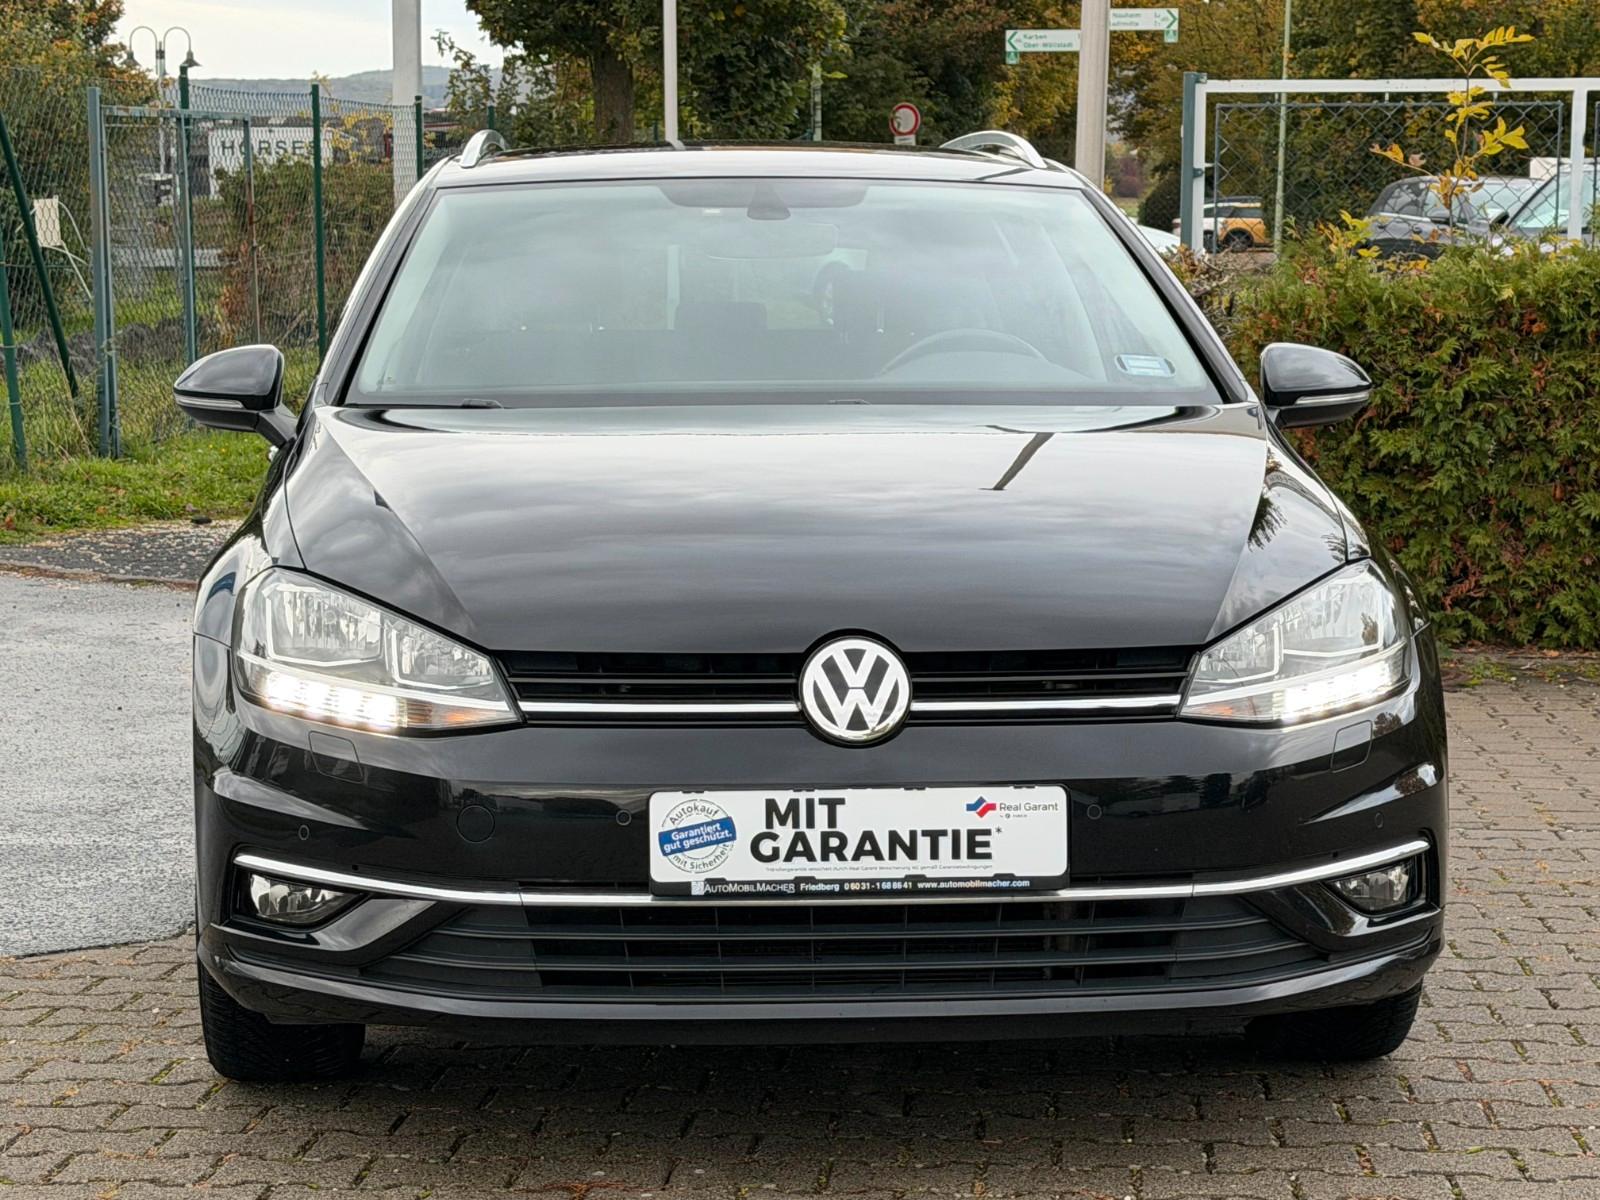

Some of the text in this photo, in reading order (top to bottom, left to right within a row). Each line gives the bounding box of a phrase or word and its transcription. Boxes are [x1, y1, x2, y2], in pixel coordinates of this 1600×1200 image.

[669, 802, 720, 825] Autokauf
[765, 797, 846, 830] MIT
[999, 802, 1059, 812] Real Garant
[671, 823, 721, 840] Garantiert
[663, 841, 682, 853] gut
[672, 843, 730, 870] mit Sicherheit
[800, 882, 840, 892] Friedberg
[917, 879, 1030, 889] www.automobilmacher.com
